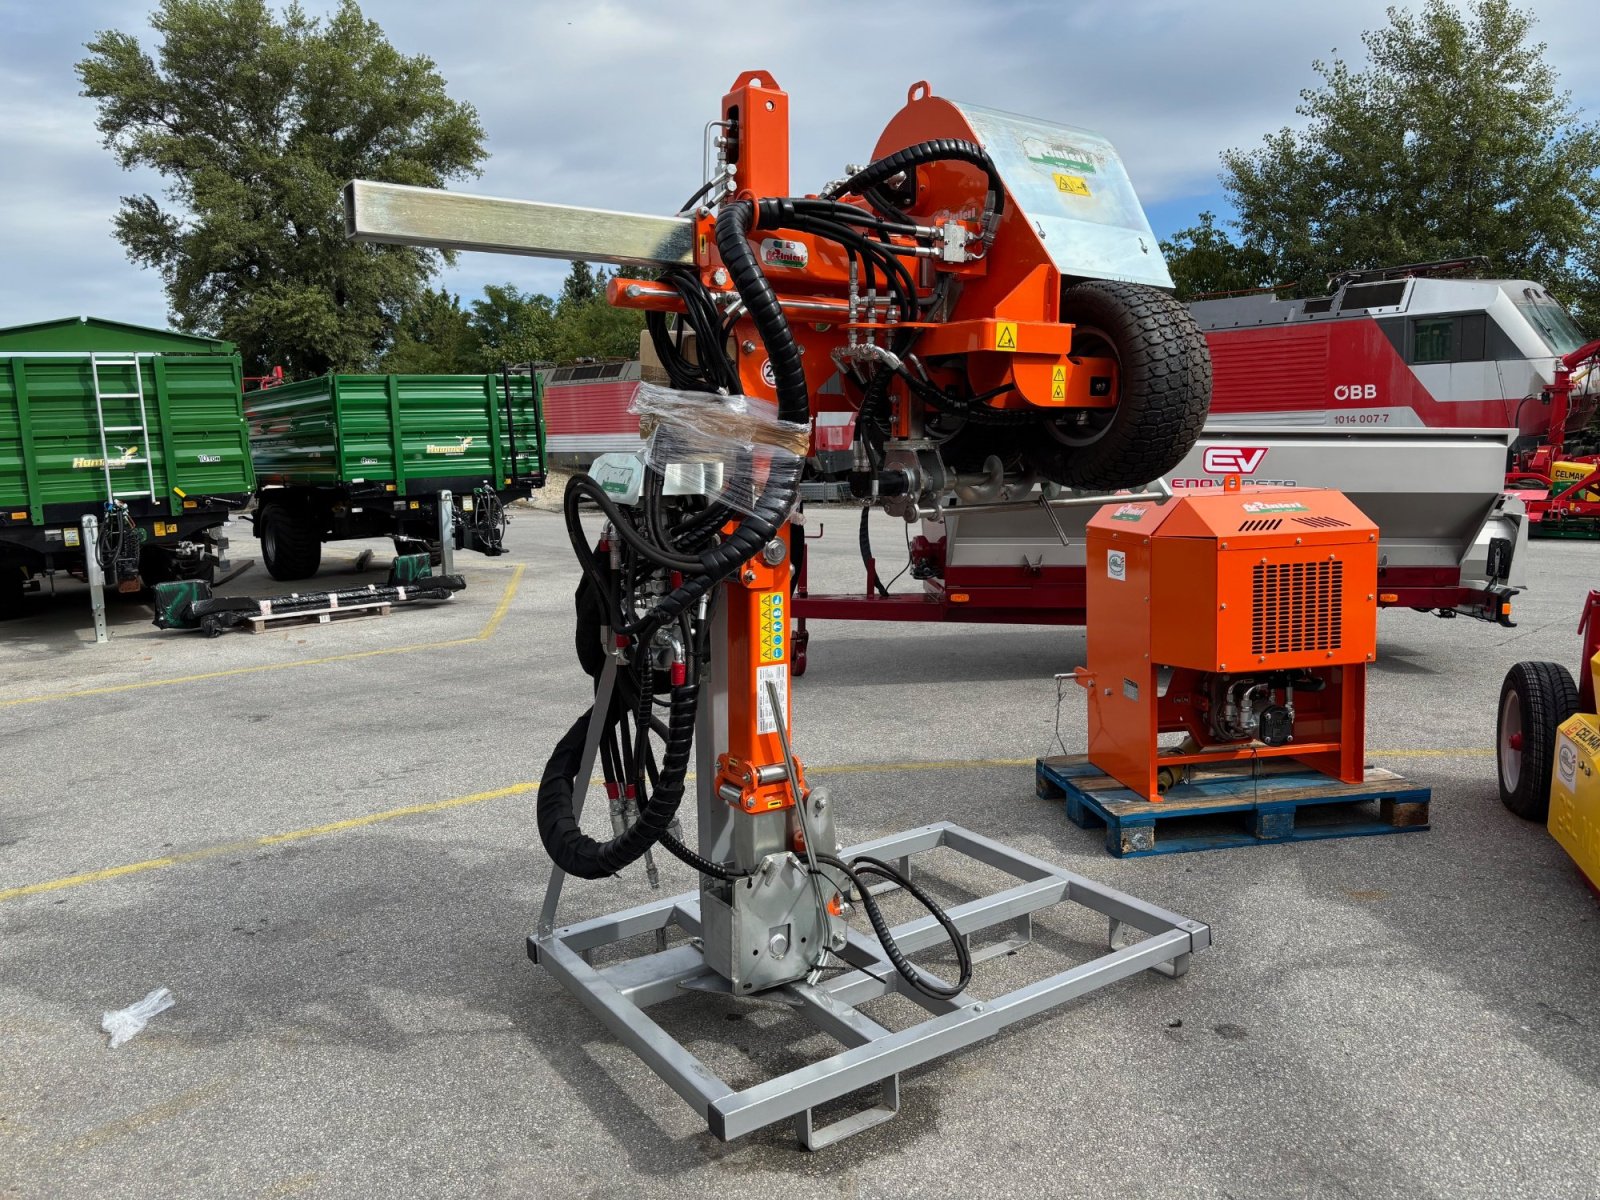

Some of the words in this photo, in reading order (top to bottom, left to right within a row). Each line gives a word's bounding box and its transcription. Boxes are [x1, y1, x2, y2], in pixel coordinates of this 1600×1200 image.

[1333, 384, 1377, 400] ÖBB
[1334, 415, 1356, 424] 1014
[1204, 448, 1265, 472] EV
[1555, 470, 1586, 481] CELMAK
